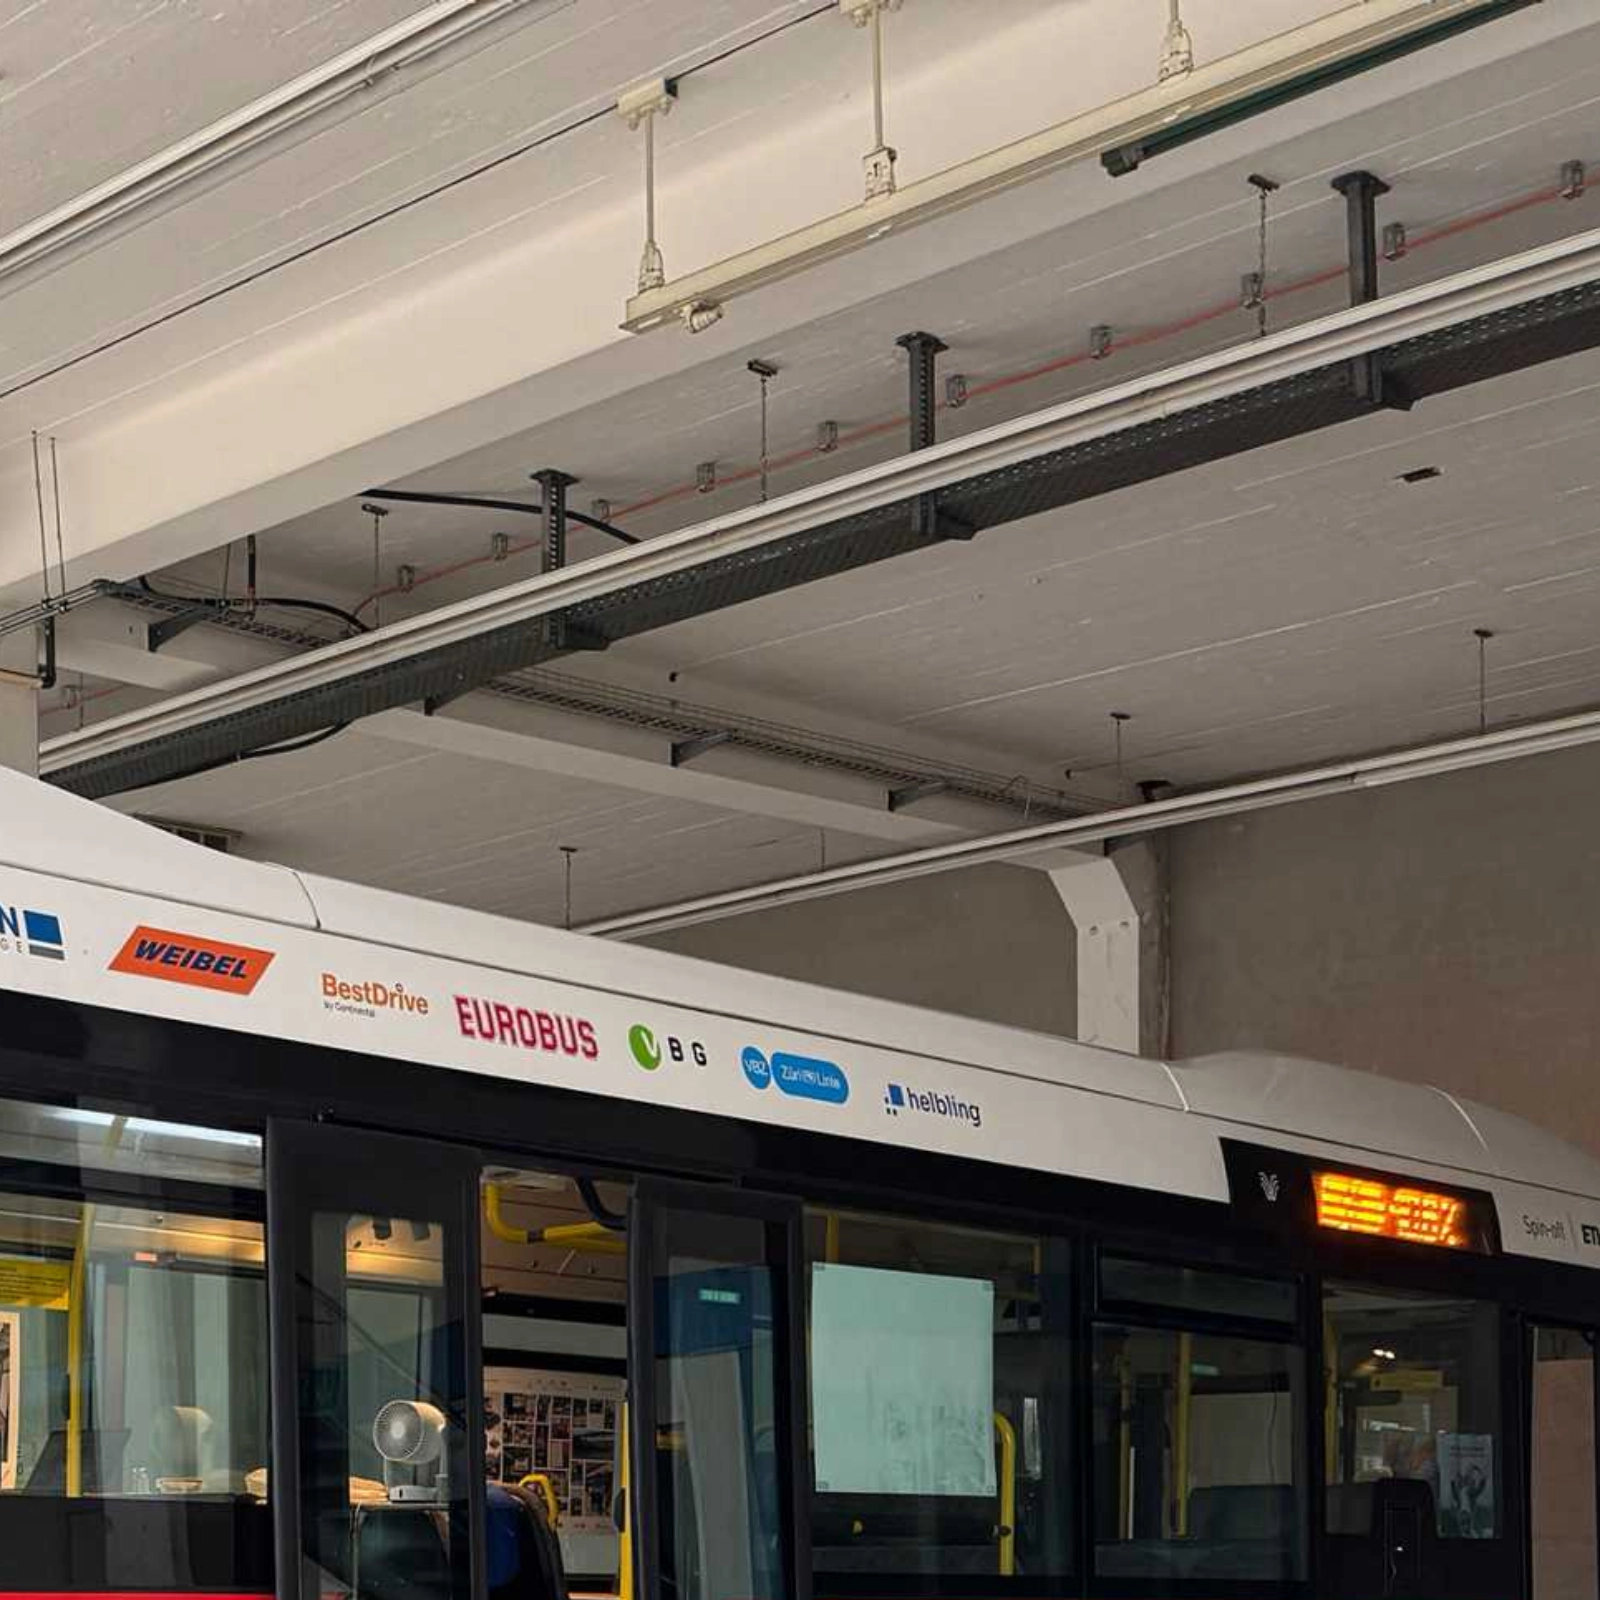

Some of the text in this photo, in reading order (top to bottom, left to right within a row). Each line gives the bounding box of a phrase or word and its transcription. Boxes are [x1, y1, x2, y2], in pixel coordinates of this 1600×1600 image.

[134, 939, 248, 979] WEIBEL
[321, 972, 429, 1015] BestDrive
[453, 994, 599, 1061] EUROBUS
[906, 1087, 982, 1127] helbling
